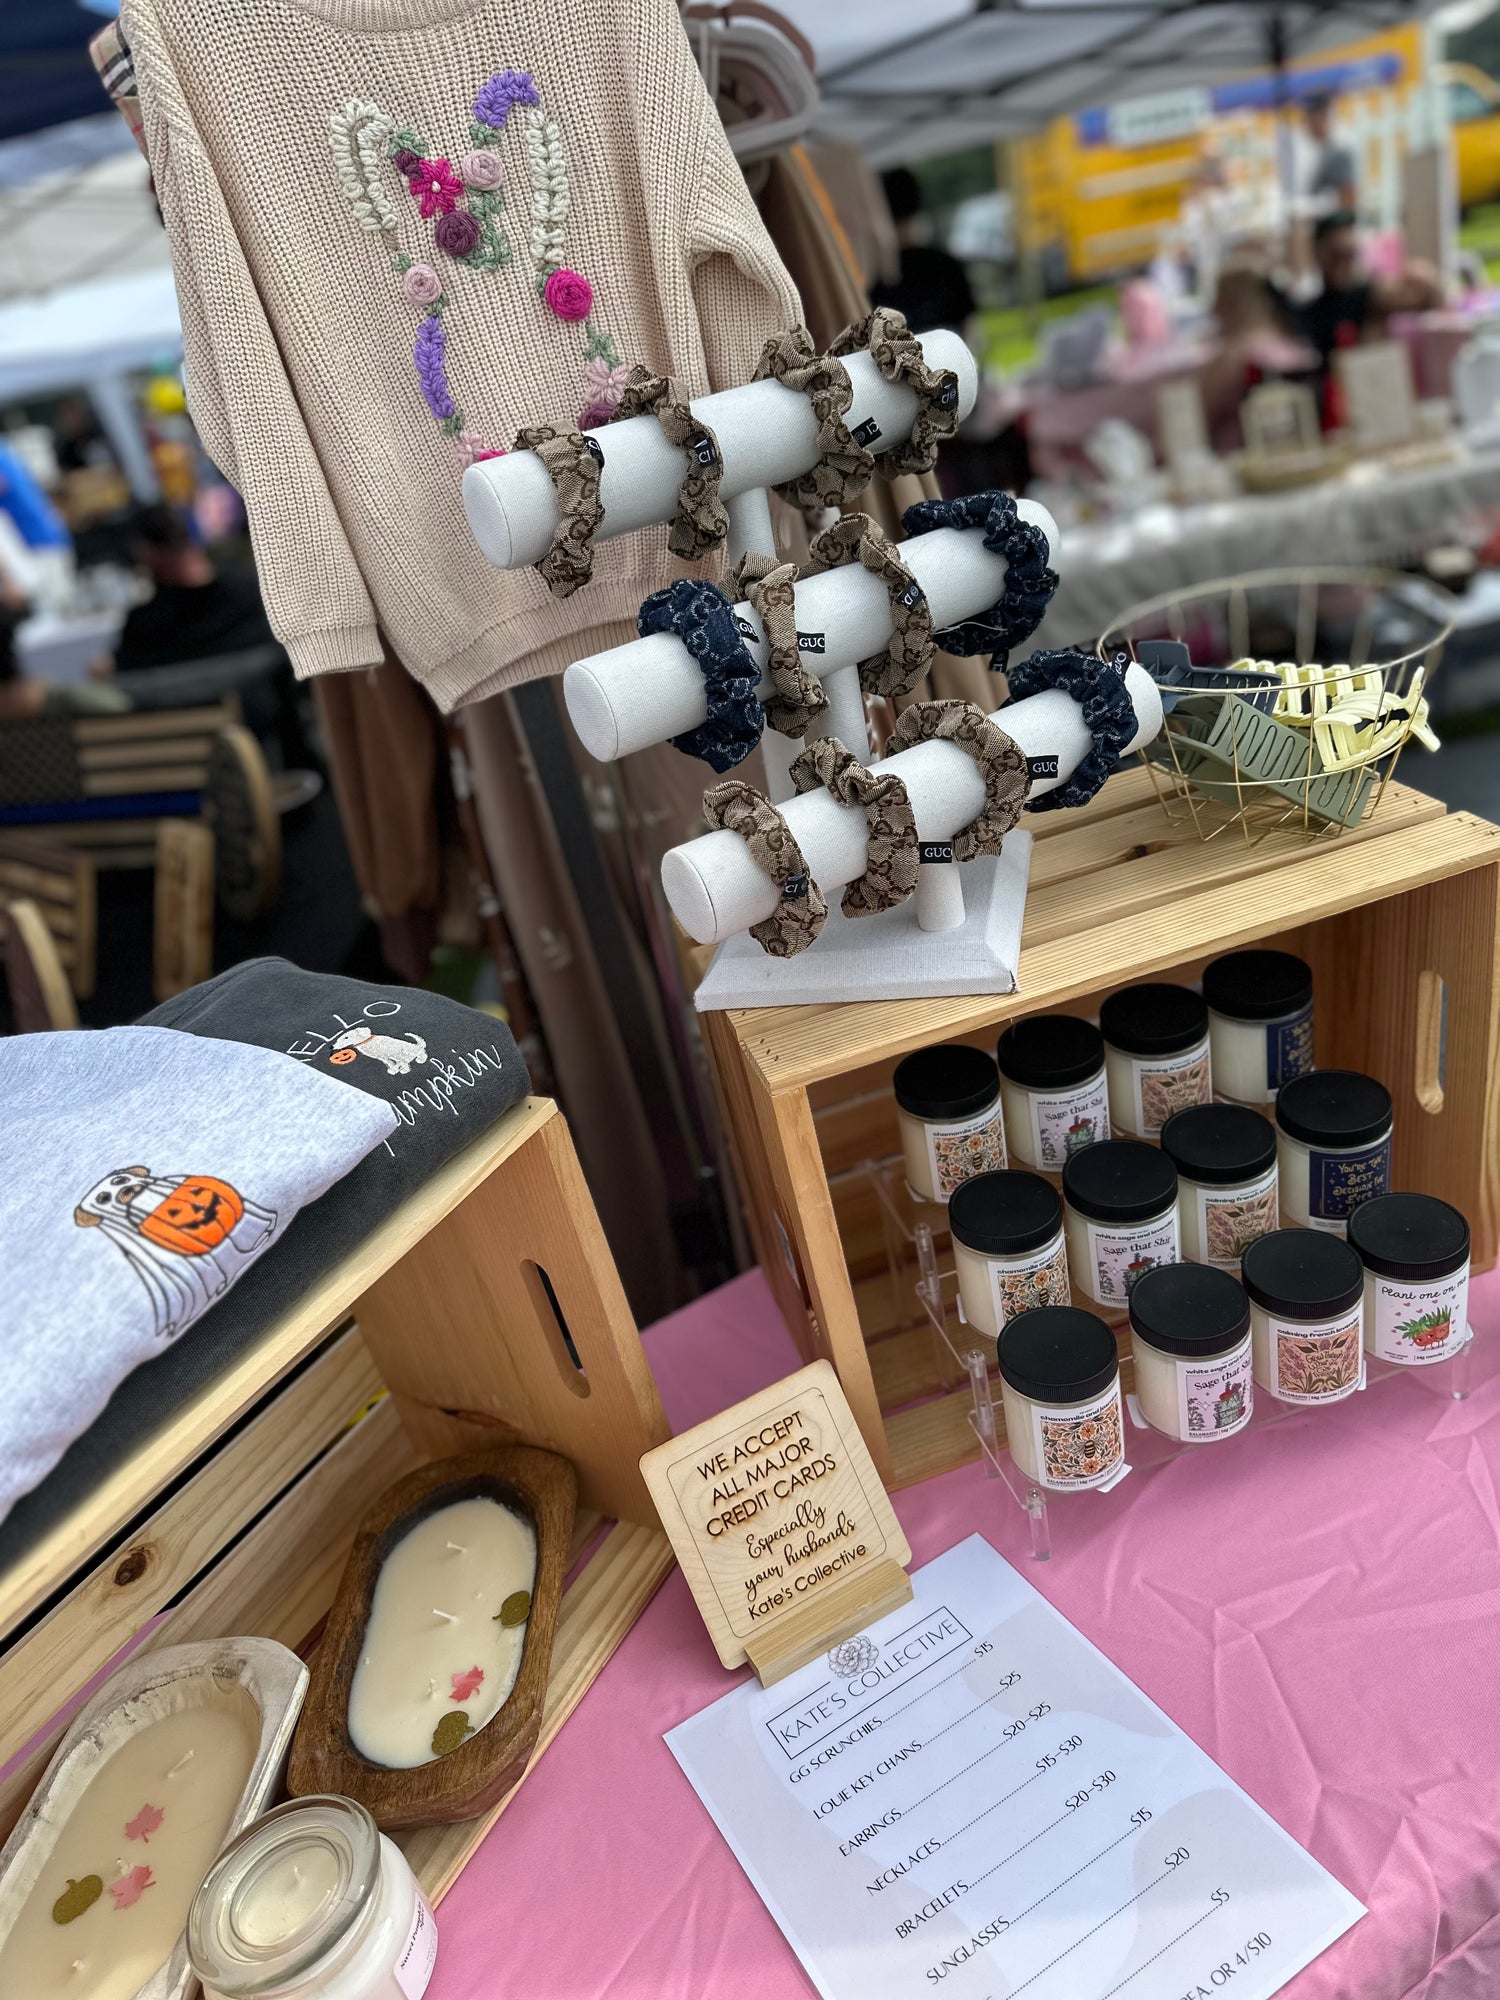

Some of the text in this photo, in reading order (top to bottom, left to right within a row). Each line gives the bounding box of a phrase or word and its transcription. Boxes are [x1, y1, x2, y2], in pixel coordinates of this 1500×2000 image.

[287, 1001, 401, 1062] ELLO
[384, 1044, 501, 1157] umpkin
[1045, 1110, 1068, 1121] Sage
[1070, 1103, 1089, 1114] that
[1095, 1232, 1116, 1240] white
[1103, 1236, 1171, 1256] Sage that Shit
[997, 1263, 1039, 1274] chamomile
[1419, 1292, 1441, 1300] one
[1442, 1285, 1455, 1295] on
[1277, 1328, 1308, 1338] calming
[1309, 1330, 1335, 1338] french
[1194, 1378, 1219, 1391] Sage
[1221, 1366, 1240, 1381] that
[1210, 1364, 1227, 1373] sage
[697, 1411, 803, 1480] WE ACCEPT
[1040, 1414, 1085, 1422] chamomile
[706, 1453, 836, 1537] CREDIT CARDS
[713, 1437, 813, 1506] ALL MAJOR
[744, 1510, 856, 1602] your husbands
[746, 1500, 826, 1559] Especially
[748, 1544, 866, 1620] Kate's Collective
[779, 1619, 958, 1744] KATE'S COLLECTIVE
[789, 1640, 994, 1784] GG SCRUNCHIES $15
[813, 1670, 1022, 1820] LOUIE KEY CHAINS $25
[839, 1807, 902, 1857] EARRINGS
[1164, 1846, 1191, 1871] $20
[866, 1838, 942, 1896] NECKLACES
[926, 1806, 1153, 1985] SUNGLASSES $15
[895, 1879, 970, 1940] BRACELETS
[1210, 1887, 1230, 1908] $5
[1210, 1962, 1237, 1986] OR
[1235, 1932, 1272, 1966] 4/$10
